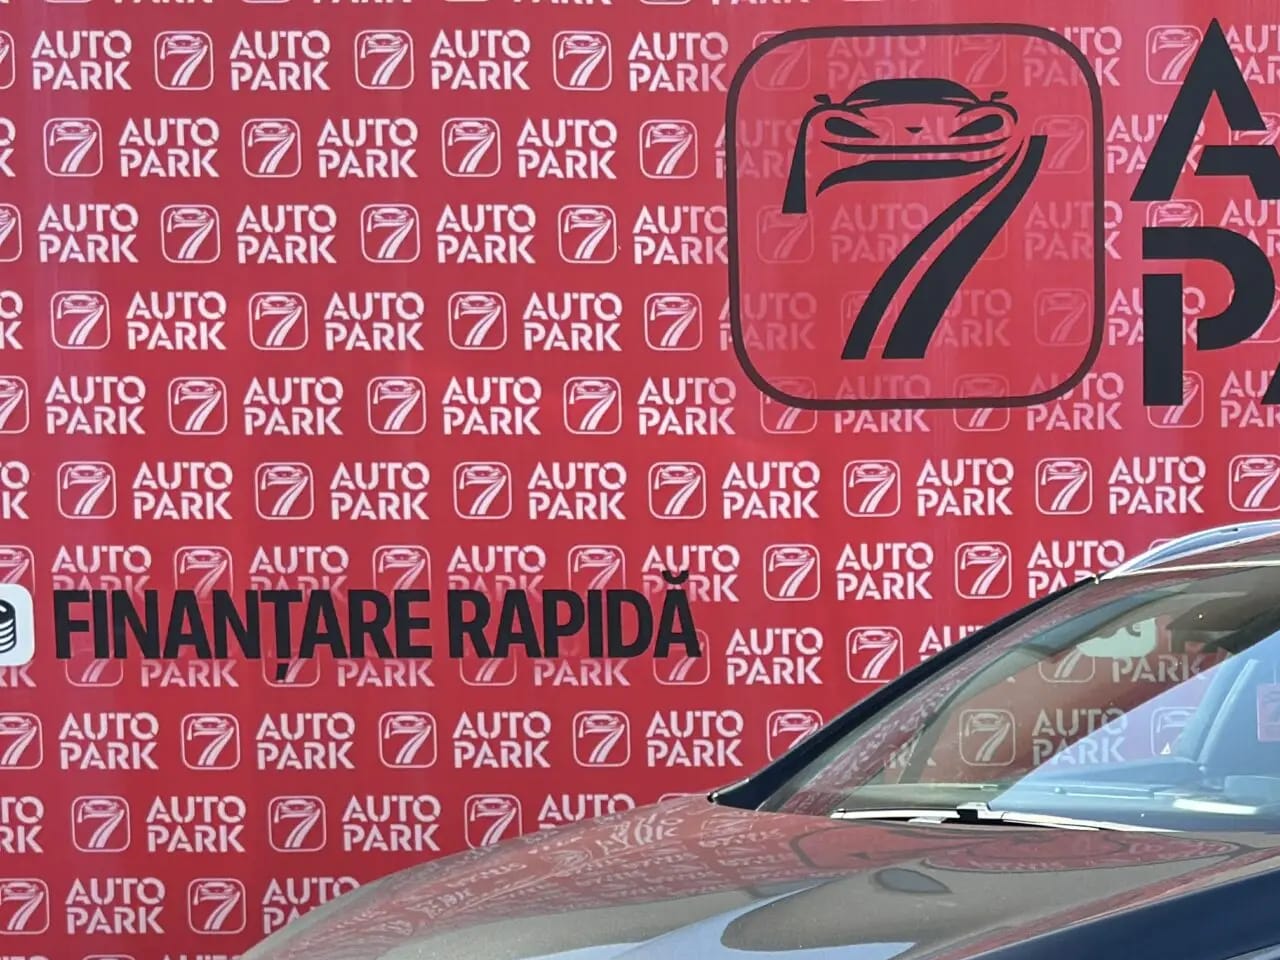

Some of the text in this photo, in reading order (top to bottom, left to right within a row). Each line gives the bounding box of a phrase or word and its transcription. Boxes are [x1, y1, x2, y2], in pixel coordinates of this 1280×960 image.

[31, 30, 131, 59] AUTO
[230, 30, 330, 59] AUTO
[430, 30, 530, 58] AUTO
[628, 32, 728, 60] AUTO
[33, 61, 131, 89] PARK
[231, 61, 330, 90] PARK
[432, 60, 530, 90] PARK
[630, 63, 726, 91] PARK
[119, 118, 219, 146] AUTO
[317, 118, 417, 147] AUTO
[517, 118, 617, 148] AUTO
[120, 149, 219, 177] PARK
[319, 149, 417, 177] PARK
[518, 149, 616, 179] PARK
[38, 204, 138, 232] AUTO
[237, 205, 336, 233] AUTO
[436, 204, 535, 232] AUTO
[633, 206, 727, 234] AUTO
[40, 234, 138, 262] PARK
[238, 235, 336, 263] PARK
[438, 235, 535, 263] PARK
[634, 236, 728, 264] PARK
[126, 291, 226, 319] AUTO
[324, 292, 424, 320] AUTO
[523, 292, 622, 321] AUTO
[128, 321, 226, 350] PARK
[326, 322, 423, 350] PARK
[525, 322, 621, 351] PARK
[45, 376, 145, 404] AUTO
[244, 376, 343, 405] AUTO
[442, 377, 541, 404] AUTO
[638, 378, 735, 405] AUTO
[47, 406, 145, 434] PARK
[245, 407, 342, 435] PARK
[444, 407, 540, 435] PARK
[639, 407, 735, 435] PARK
[835, 409, 930, 433] PARK
[1027, 402, 1122, 431] PARK
[133, 462, 232, 489] AUTO
[330, 462, 429, 490] AUTO
[528, 462, 626, 490] AUTO
[722, 461, 820, 489] AUTO
[917, 458, 1013, 486] AUTO
[1109, 456, 1205, 484] AUTO
[134, 492, 232, 519] PARK
[332, 492, 429, 520] PARK
[529, 492, 625, 519] PARK
[724, 491, 818, 519] PARK
[918, 487, 1012, 516] PARK
[1110, 486, 1204, 514] PARK
[52, 545, 151, 573] AUTO
[249, 545, 349, 573] AUTO
[448, 545, 546, 573] AUTO
[642, 545, 740, 572] AUTO
[836, 542, 933, 570] AUTO
[1028, 540, 1125, 568] AUTO
[837, 572, 932, 600] PARK
[53, 569, 703, 681] FINANȚARE RAPIDĂ
[726, 628, 823, 655] AUTO
[141, 660, 239, 687] PARK
[337, 660, 433, 687] PARK
[530, 659, 629, 687] PARK
[727, 657, 822, 685] PARK
[59, 712, 158, 740] AUTO
[256, 712, 355, 740] AUTO
[453, 711, 551, 739] AUTO
[646, 710, 743, 737] AUTO
[61, 742, 158, 769] PARK
[257, 742, 354, 769] PARK
[454, 741, 550, 768] PARK
[647, 739, 742, 767] PARK
[146, 796, 246, 823] AUTO
[342, 795, 441, 822] AUTO
[148, 825, 245, 852] PARK
[344, 824, 440, 851] PARK
[66, 877, 165, 904] AUTO
[67, 907, 164, 934] PARK
